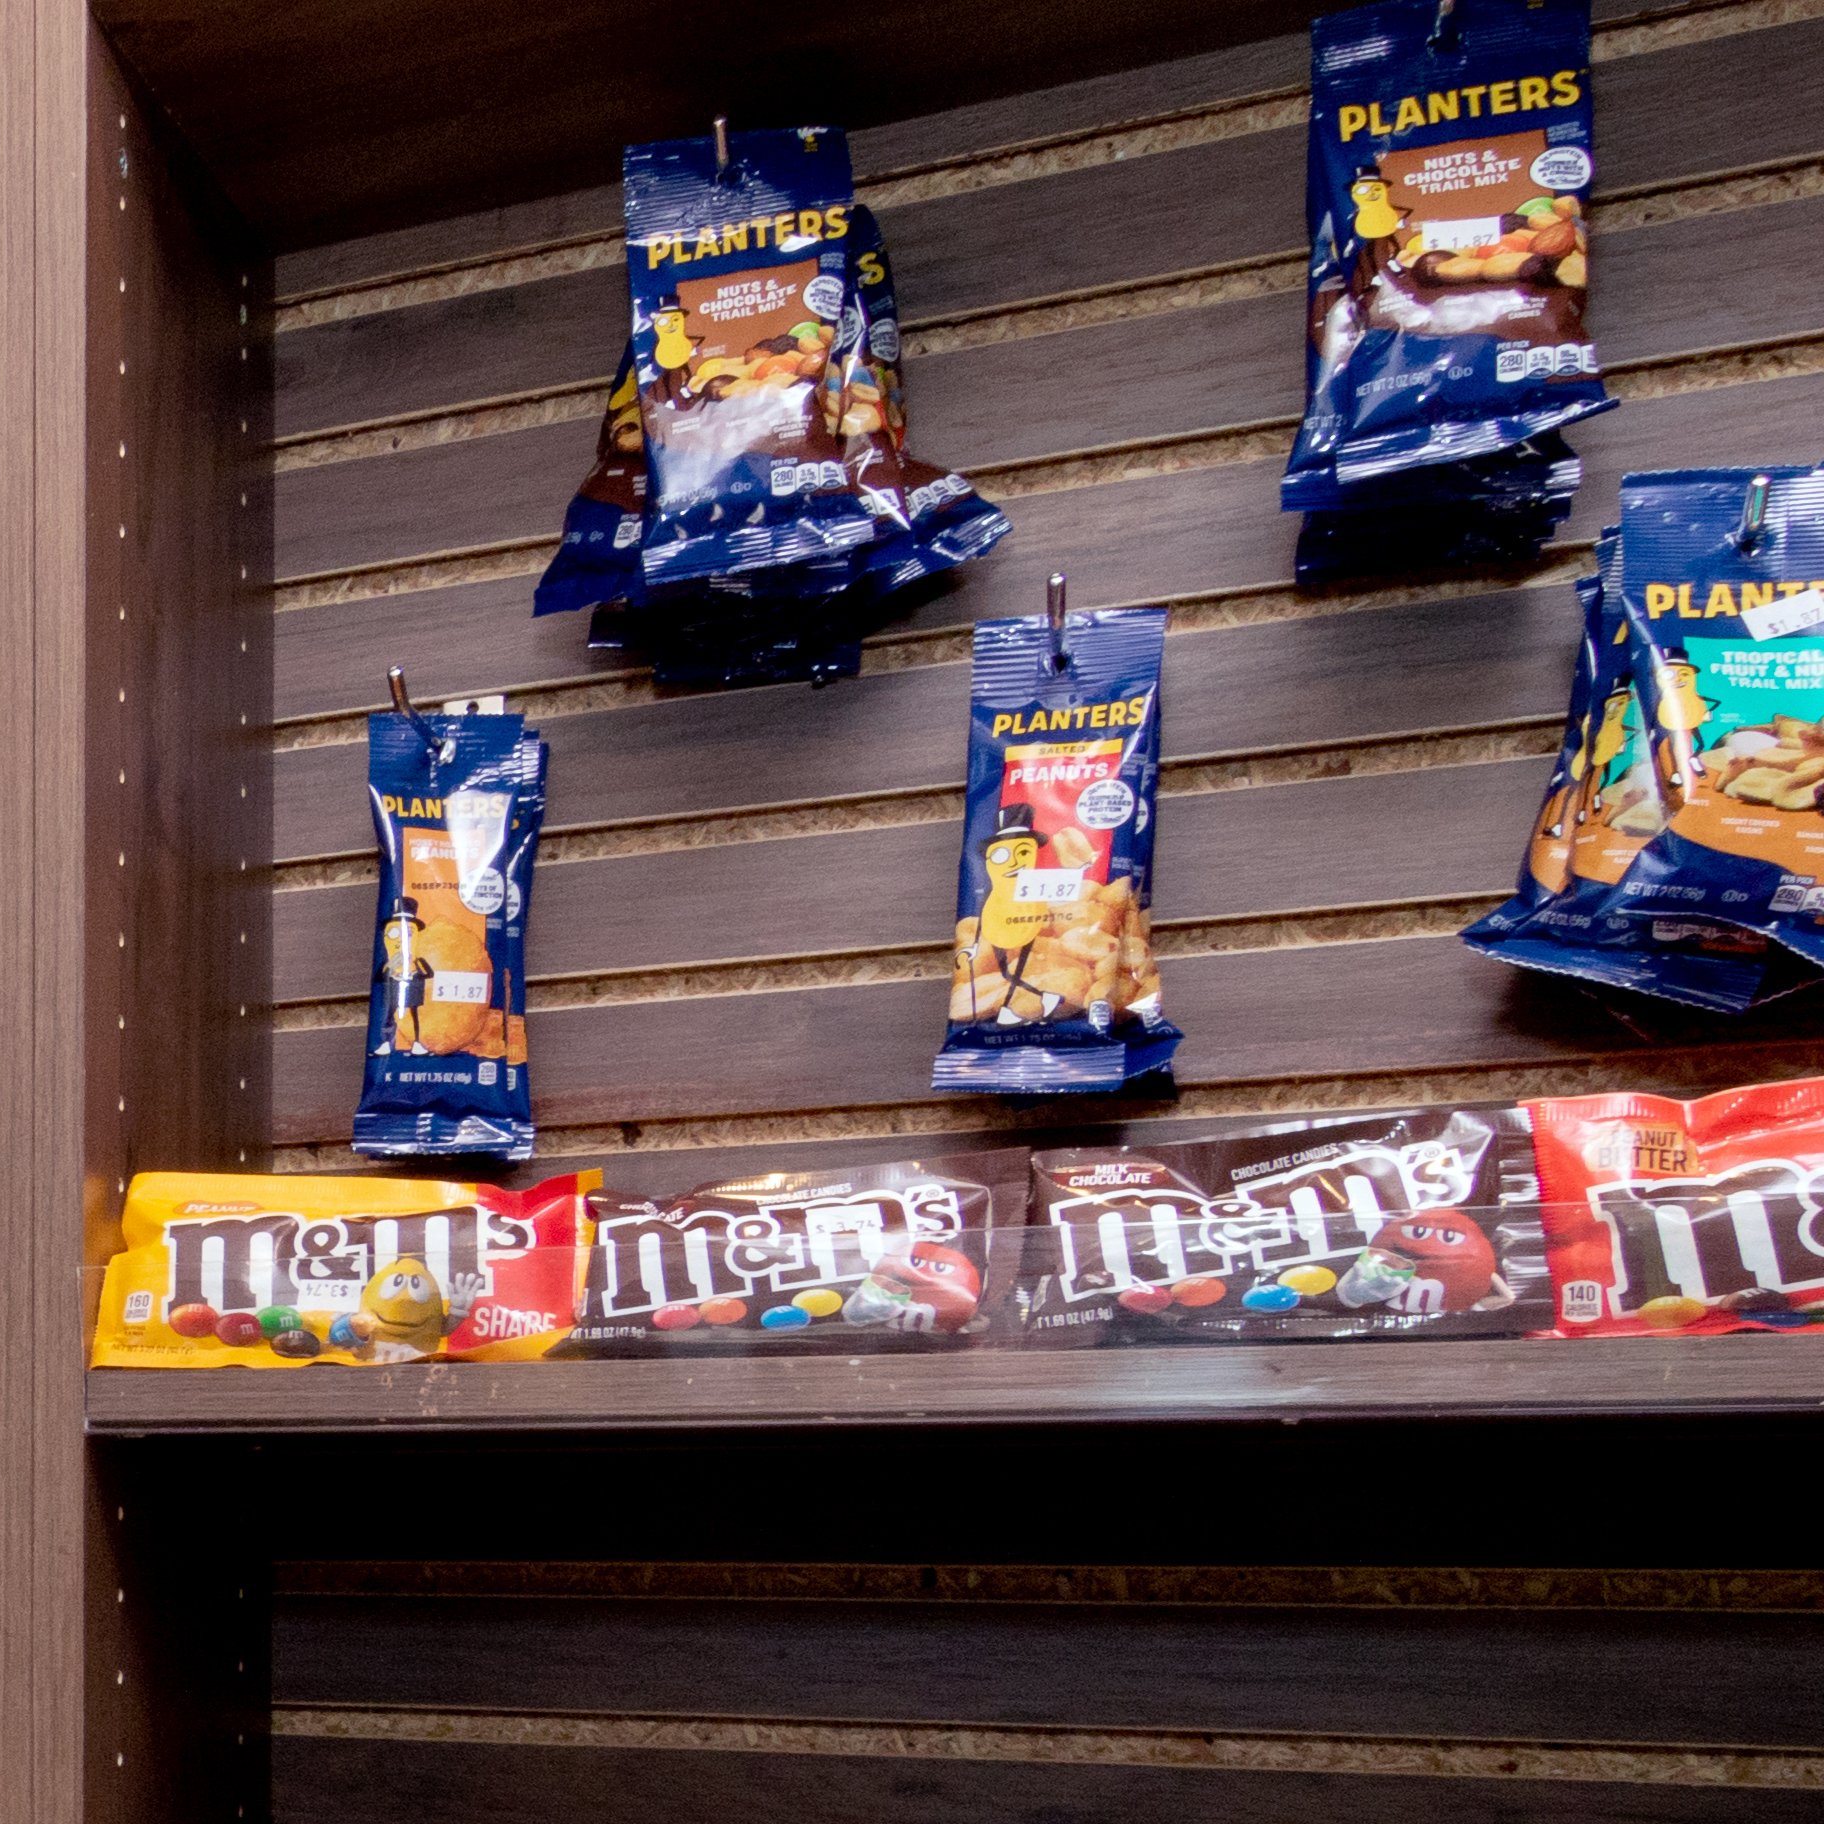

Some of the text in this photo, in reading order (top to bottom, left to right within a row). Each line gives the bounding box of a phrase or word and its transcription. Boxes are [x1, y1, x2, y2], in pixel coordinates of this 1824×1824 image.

[1338, 70, 1581, 142] PLANTERS
[1424, 150, 1497, 170] NUTS &
[1404, 157, 1522, 186] CHOCOLATE
[1418, 172, 1509, 195] TRAIL MIX
[647, 205, 849, 269] PLANTERS
[717, 279, 778, 298] NUTS &
[699, 285, 797, 315] CHOCOLATE
[712, 298, 786, 322] TRAIL MIX
[1721, 652, 1822, 664] TROPICAL
[1711, 664, 1788, 676] FRUIT &
[1728, 677, 1822, 688] TRAIL MIX
[992, 696, 1143, 737] PLANTERS
[1010, 763, 1107, 785] PEANUTS
[384, 795, 505, 818] PLANTERS
[1094, 1162, 1128, 1175] MILK
[1231, 1144, 1338, 1179] CHOCOLATE CANDIES
[1069, 1173, 1151, 1186] CHOCOLATE
[128, 1294, 150, 1311] 160
[1567, 1285, 1596, 1303] 140
[472, 1306, 555, 1339] SHARE
